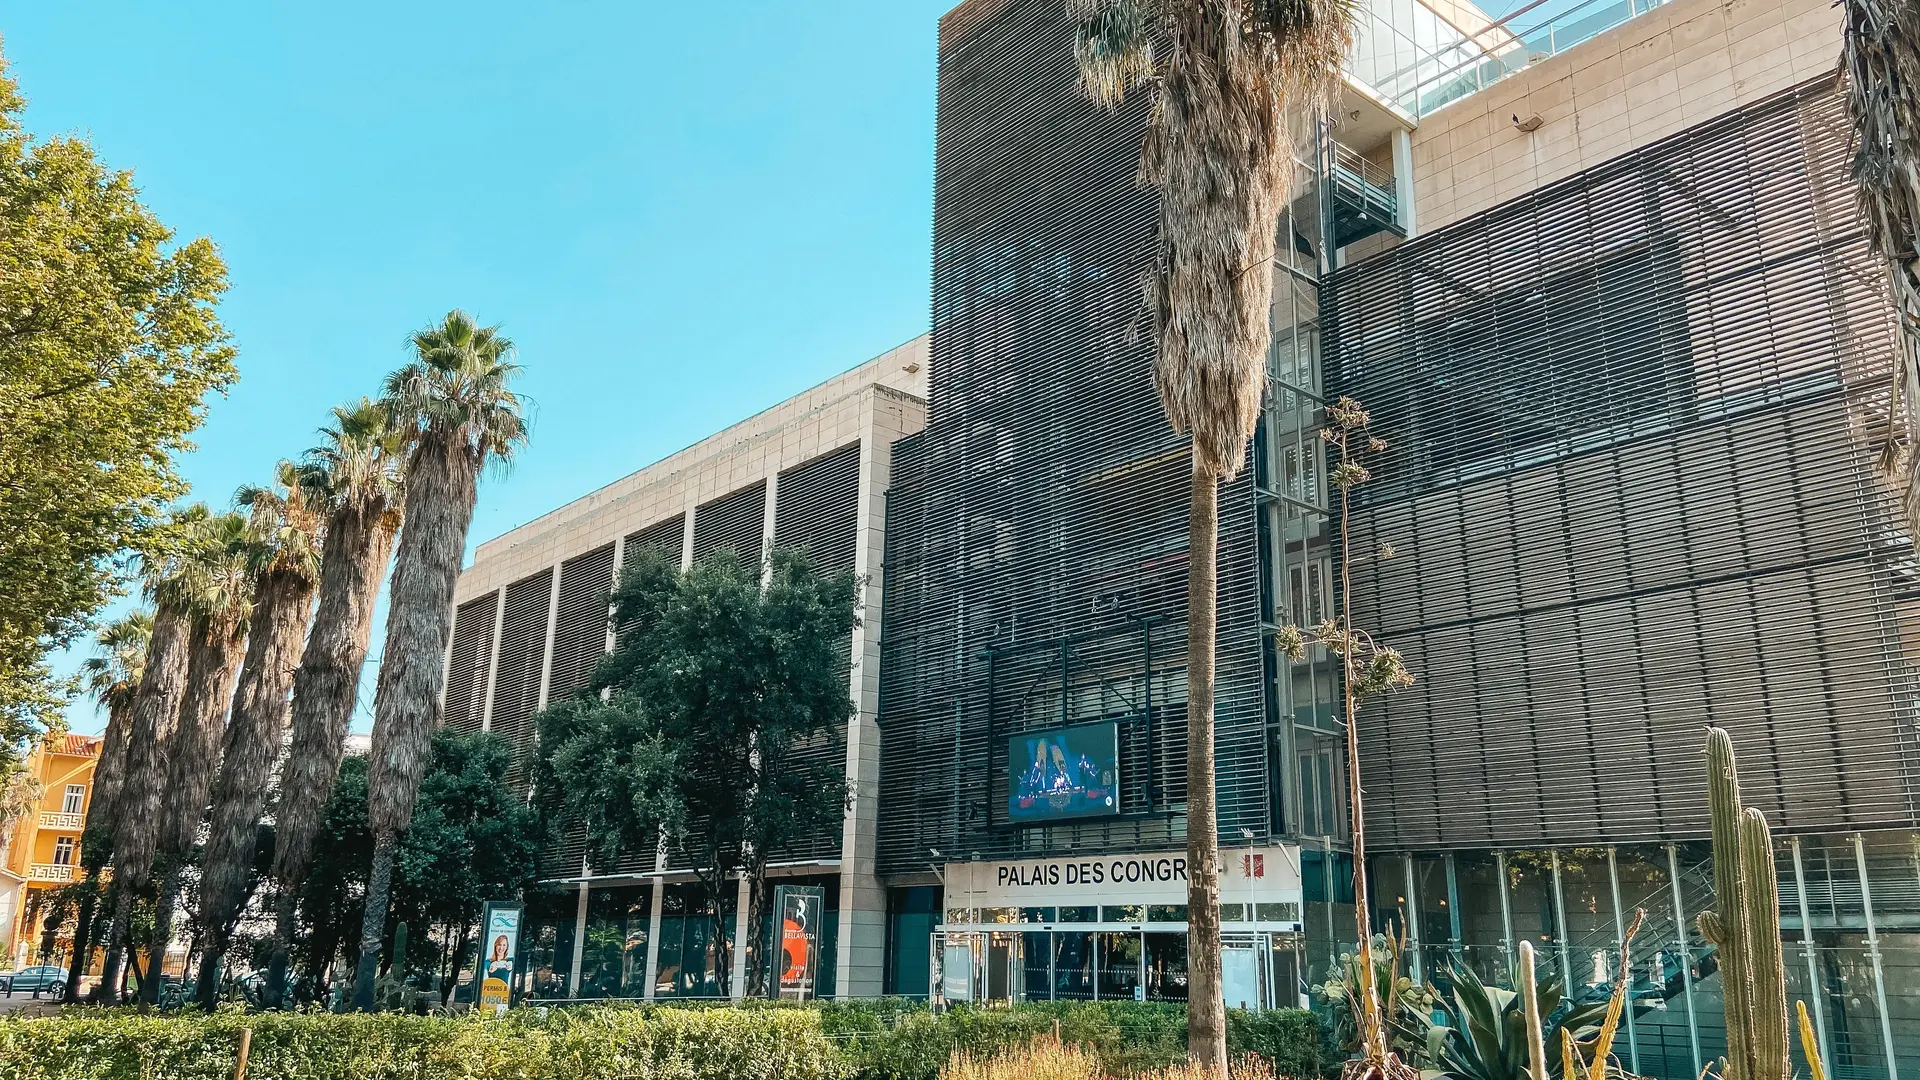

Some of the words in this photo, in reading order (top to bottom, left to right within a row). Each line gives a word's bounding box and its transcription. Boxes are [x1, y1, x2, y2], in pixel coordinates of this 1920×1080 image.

[998, 864, 1060, 886] PALAIS
[1066, 862, 1105, 884] DES
[1110, 858, 1188, 883] CONGR
